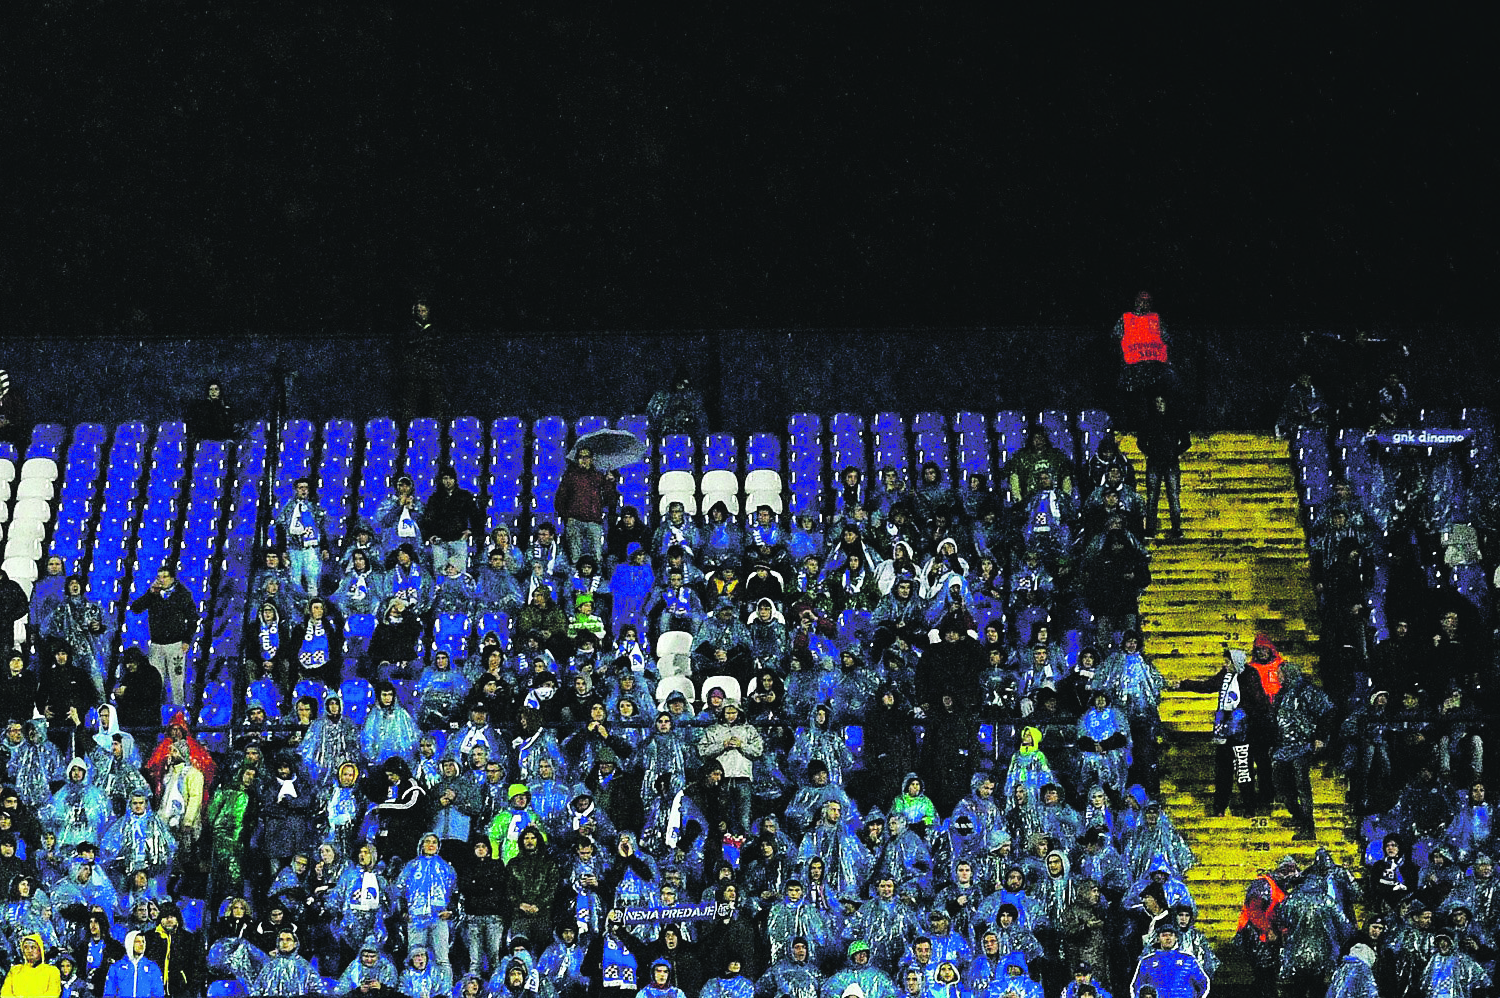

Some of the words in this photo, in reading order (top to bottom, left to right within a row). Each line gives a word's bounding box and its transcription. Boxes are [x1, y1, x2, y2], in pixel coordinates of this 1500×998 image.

[1393, 430, 1416, 443] gnk
[1418, 430, 1465, 443] dinamo
[1236, 743, 1251, 784] BOXING
[626, 909, 660, 921] NEMA
[661, 904, 716, 919] PREDAJE
